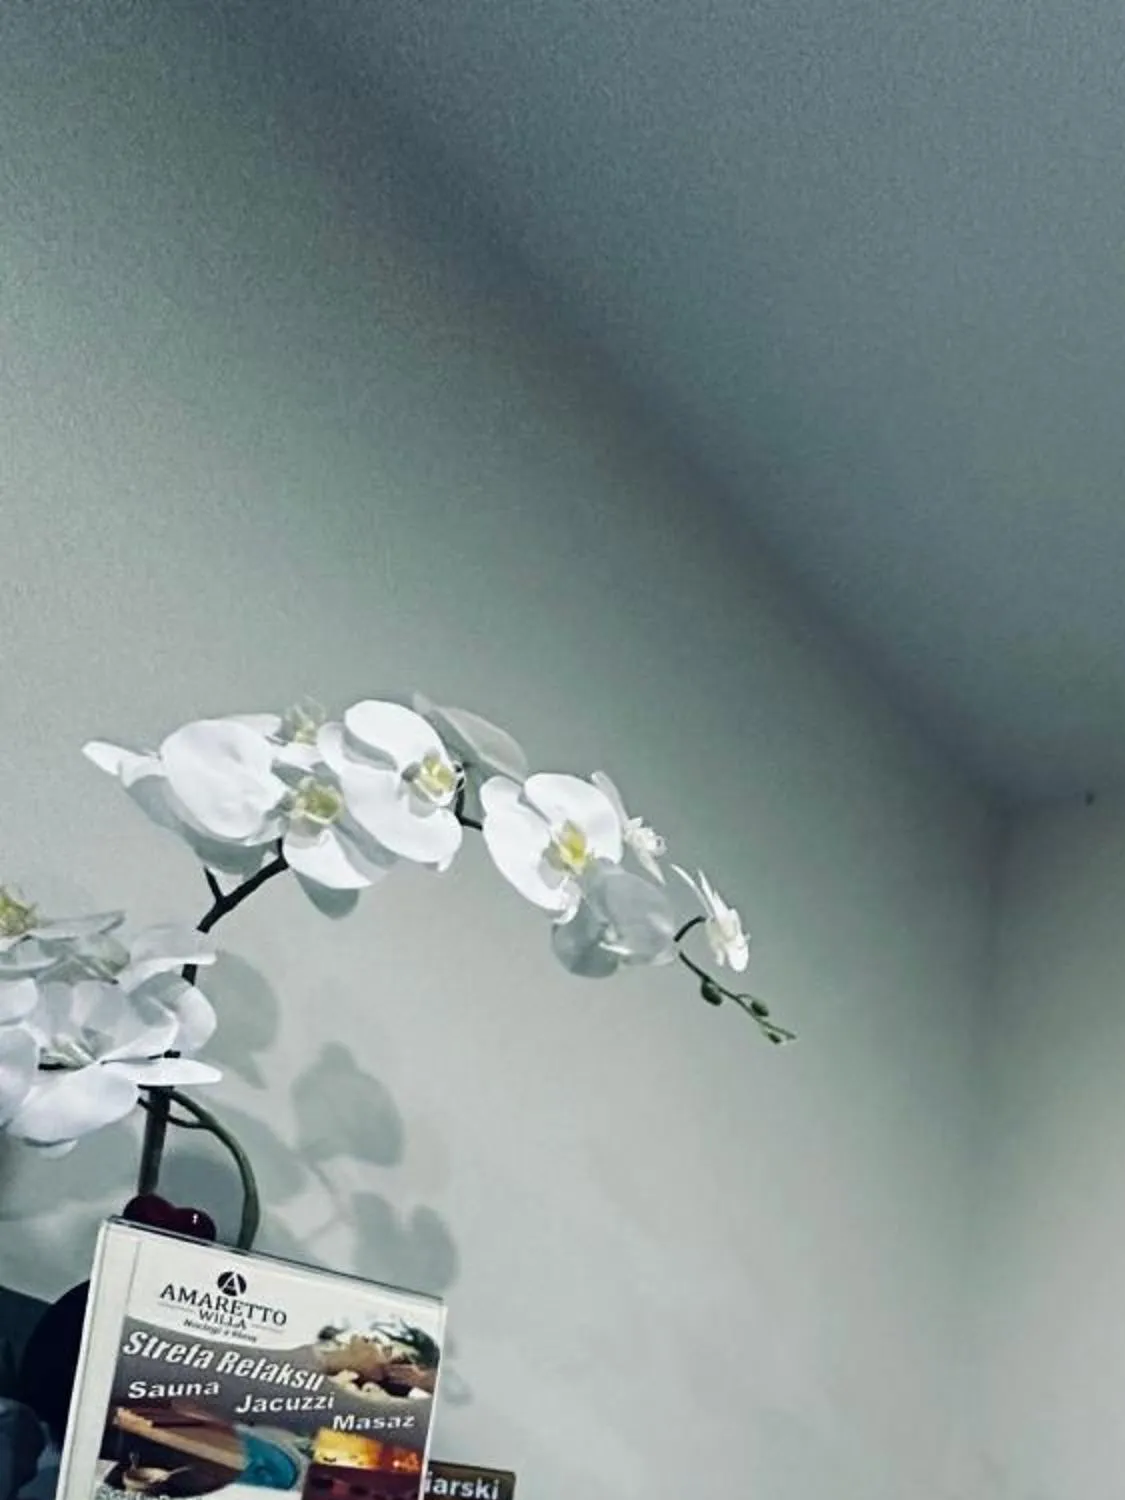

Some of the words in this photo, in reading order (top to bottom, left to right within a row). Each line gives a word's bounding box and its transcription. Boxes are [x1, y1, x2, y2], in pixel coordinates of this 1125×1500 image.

[160, 1283, 287, 1326] AMARETTO
[200, 1309, 247, 1330] WILLA
[122, 1331, 215, 1370] Strefa
[216, 1349, 325, 1392] Relaksu
[127, 1381, 220, 1399] Sauna
[235, 1392, 335, 1414] Jacuzzi
